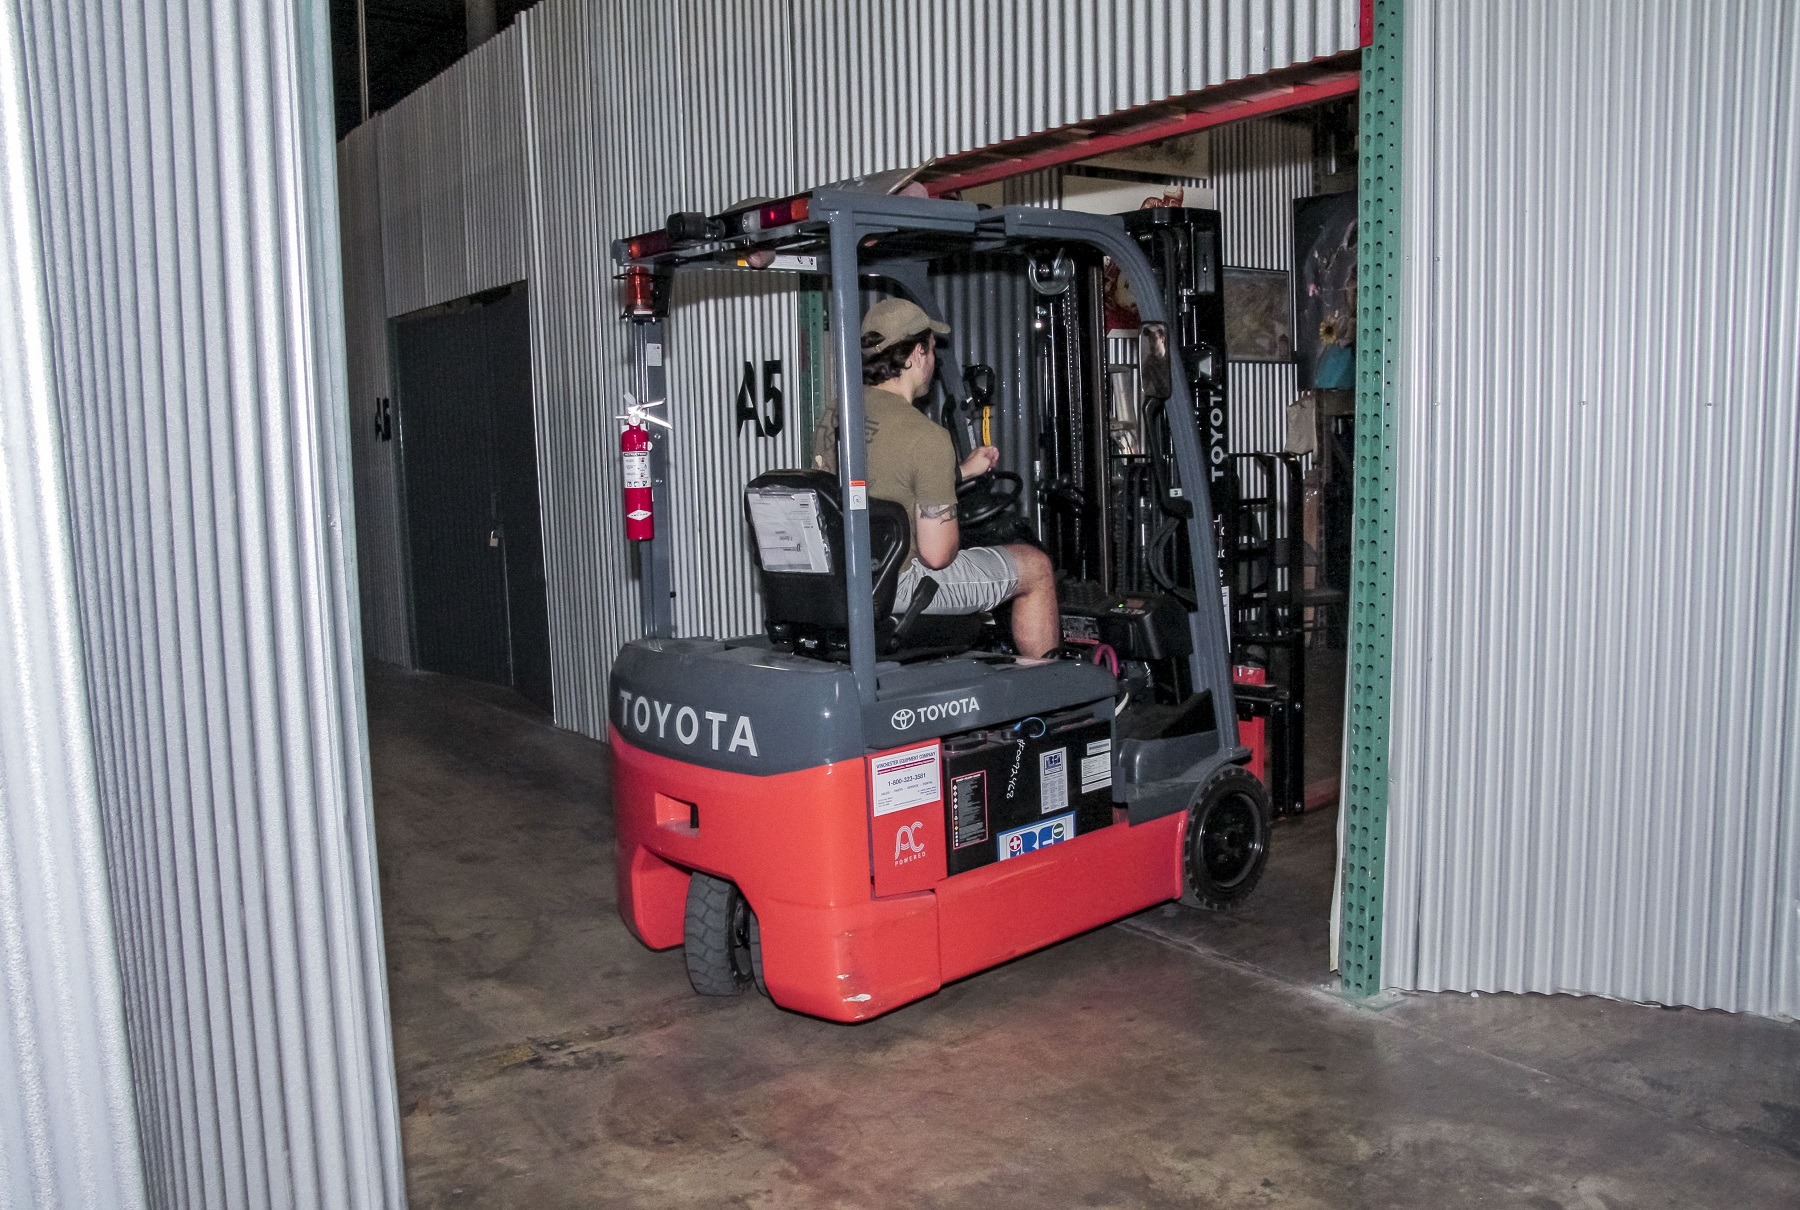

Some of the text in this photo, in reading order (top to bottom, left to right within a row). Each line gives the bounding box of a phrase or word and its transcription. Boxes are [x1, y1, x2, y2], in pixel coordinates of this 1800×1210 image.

[737, 360, 783, 438] A5
[1209, 384, 1223, 482] TOYOT
[619, 688, 759, 757] TOYOTA
[917, 697, 980, 722] TOYOTA
[894, 851, 926, 867] POWERED
